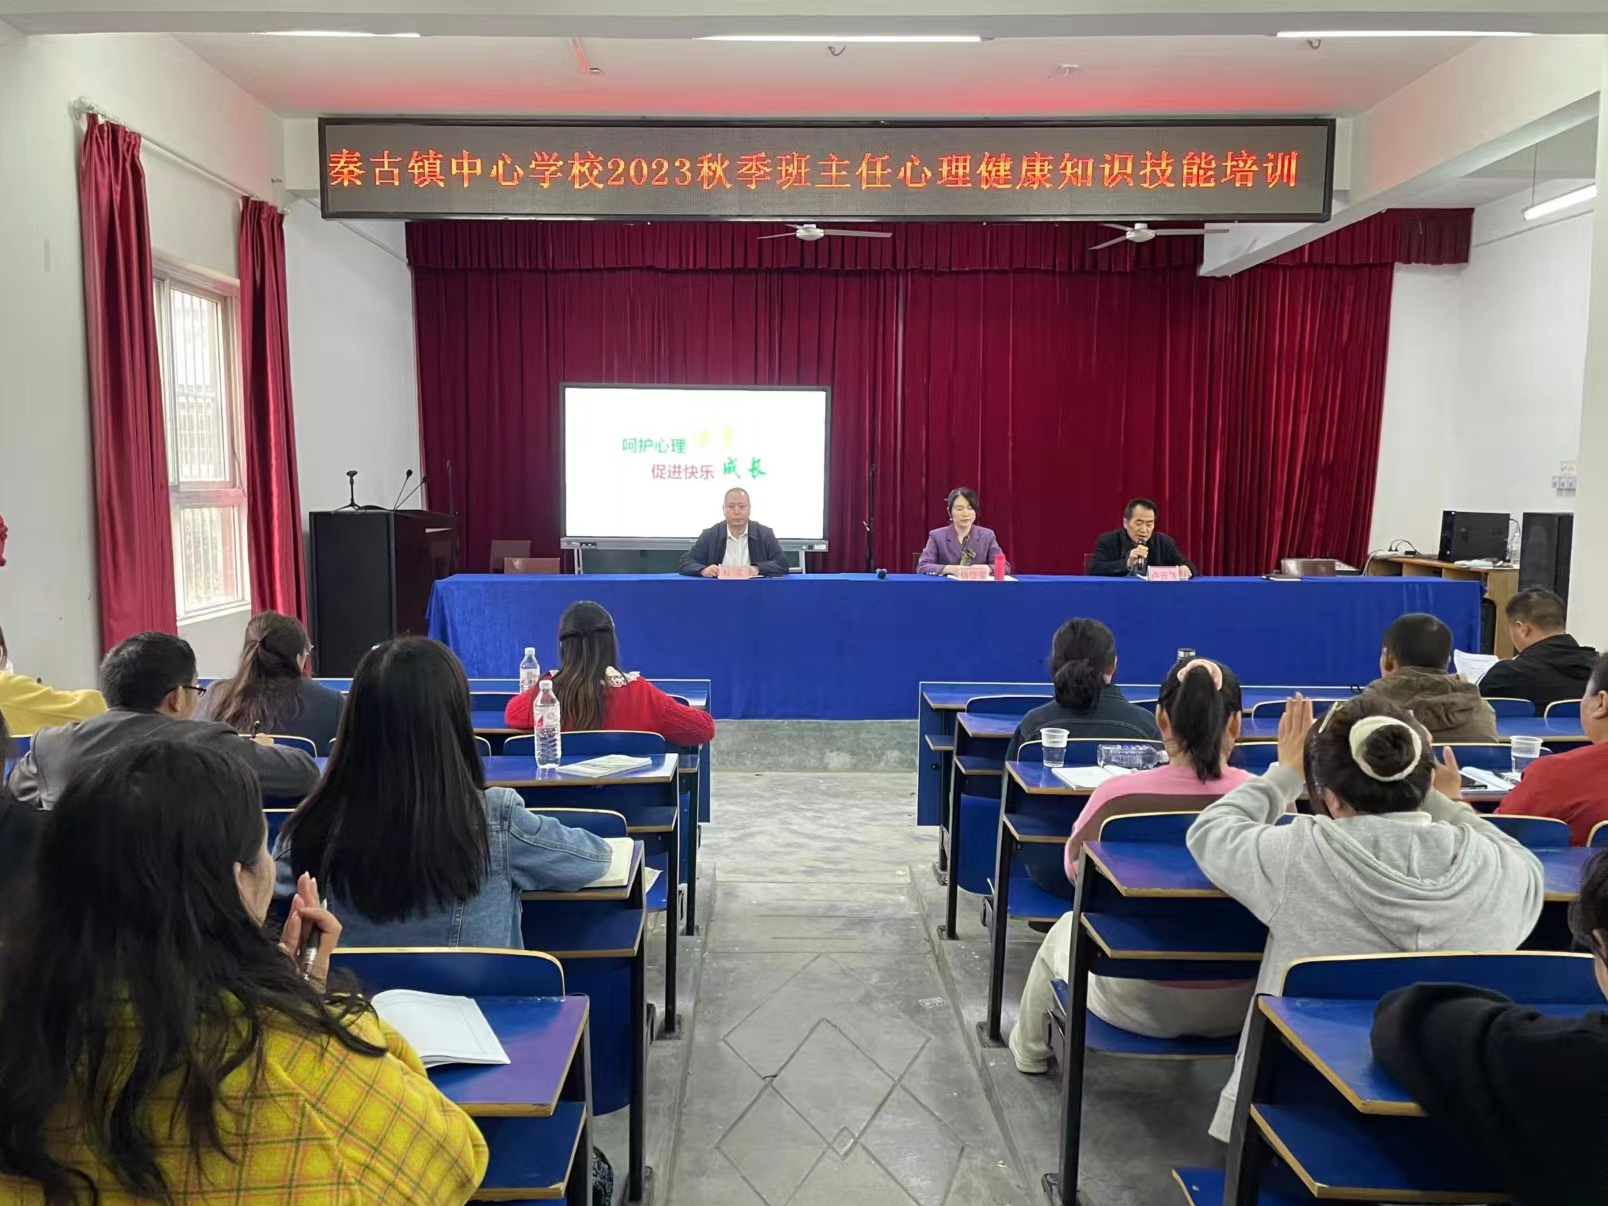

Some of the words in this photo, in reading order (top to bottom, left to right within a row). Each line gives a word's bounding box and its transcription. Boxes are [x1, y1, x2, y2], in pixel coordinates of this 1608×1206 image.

[328, 148, 1299, 190] 秦古镇中心学校2023秋季班主任心理健康知识技能培训
[622, 438, 686, 454] 呵护心理
[651, 463, 714, 480] 促进快乐
[722, 456, 767, 479] 成长
